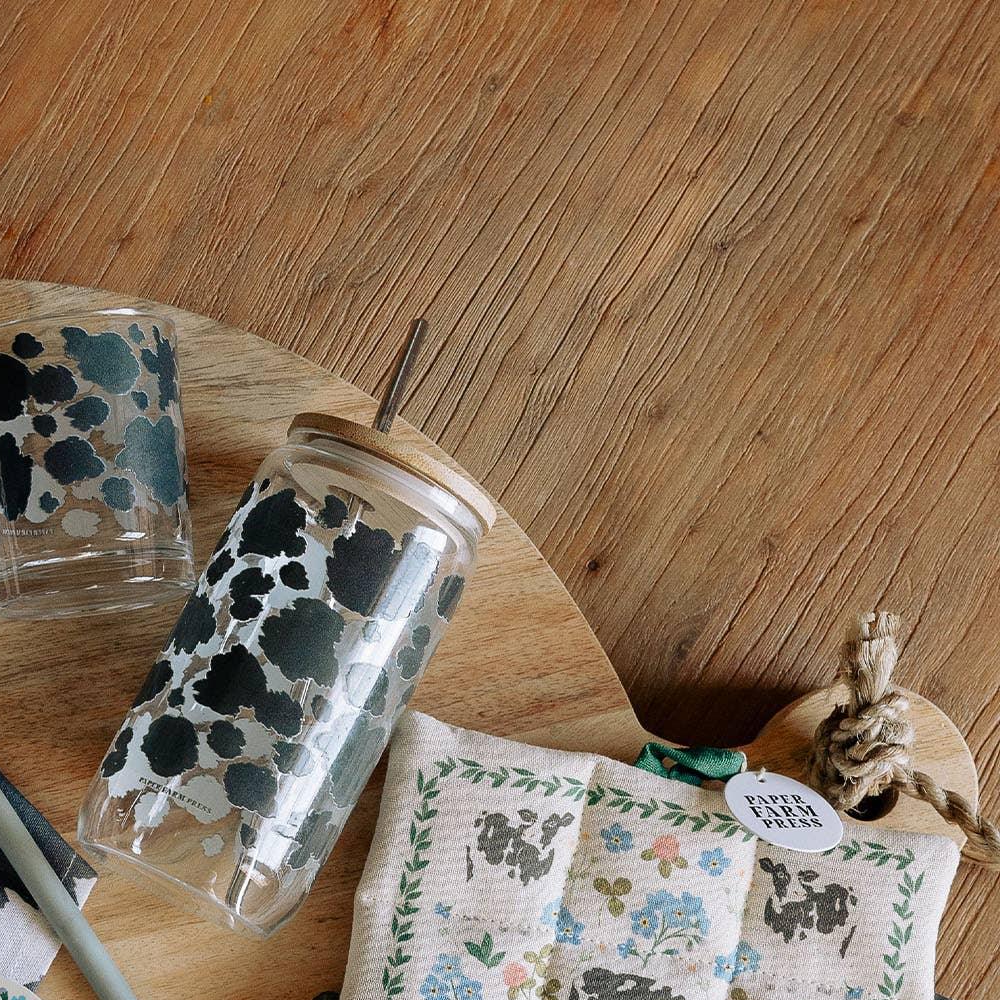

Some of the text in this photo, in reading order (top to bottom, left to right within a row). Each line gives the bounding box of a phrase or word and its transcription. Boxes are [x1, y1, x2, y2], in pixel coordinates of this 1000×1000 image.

[162, 786, 186, 801] FARM
[187, 798, 212, 814] PRESS
[744, 795, 806, 805] PAPER
[750, 805, 819, 818] FARM
[762, 818, 823, 829] PRESS
